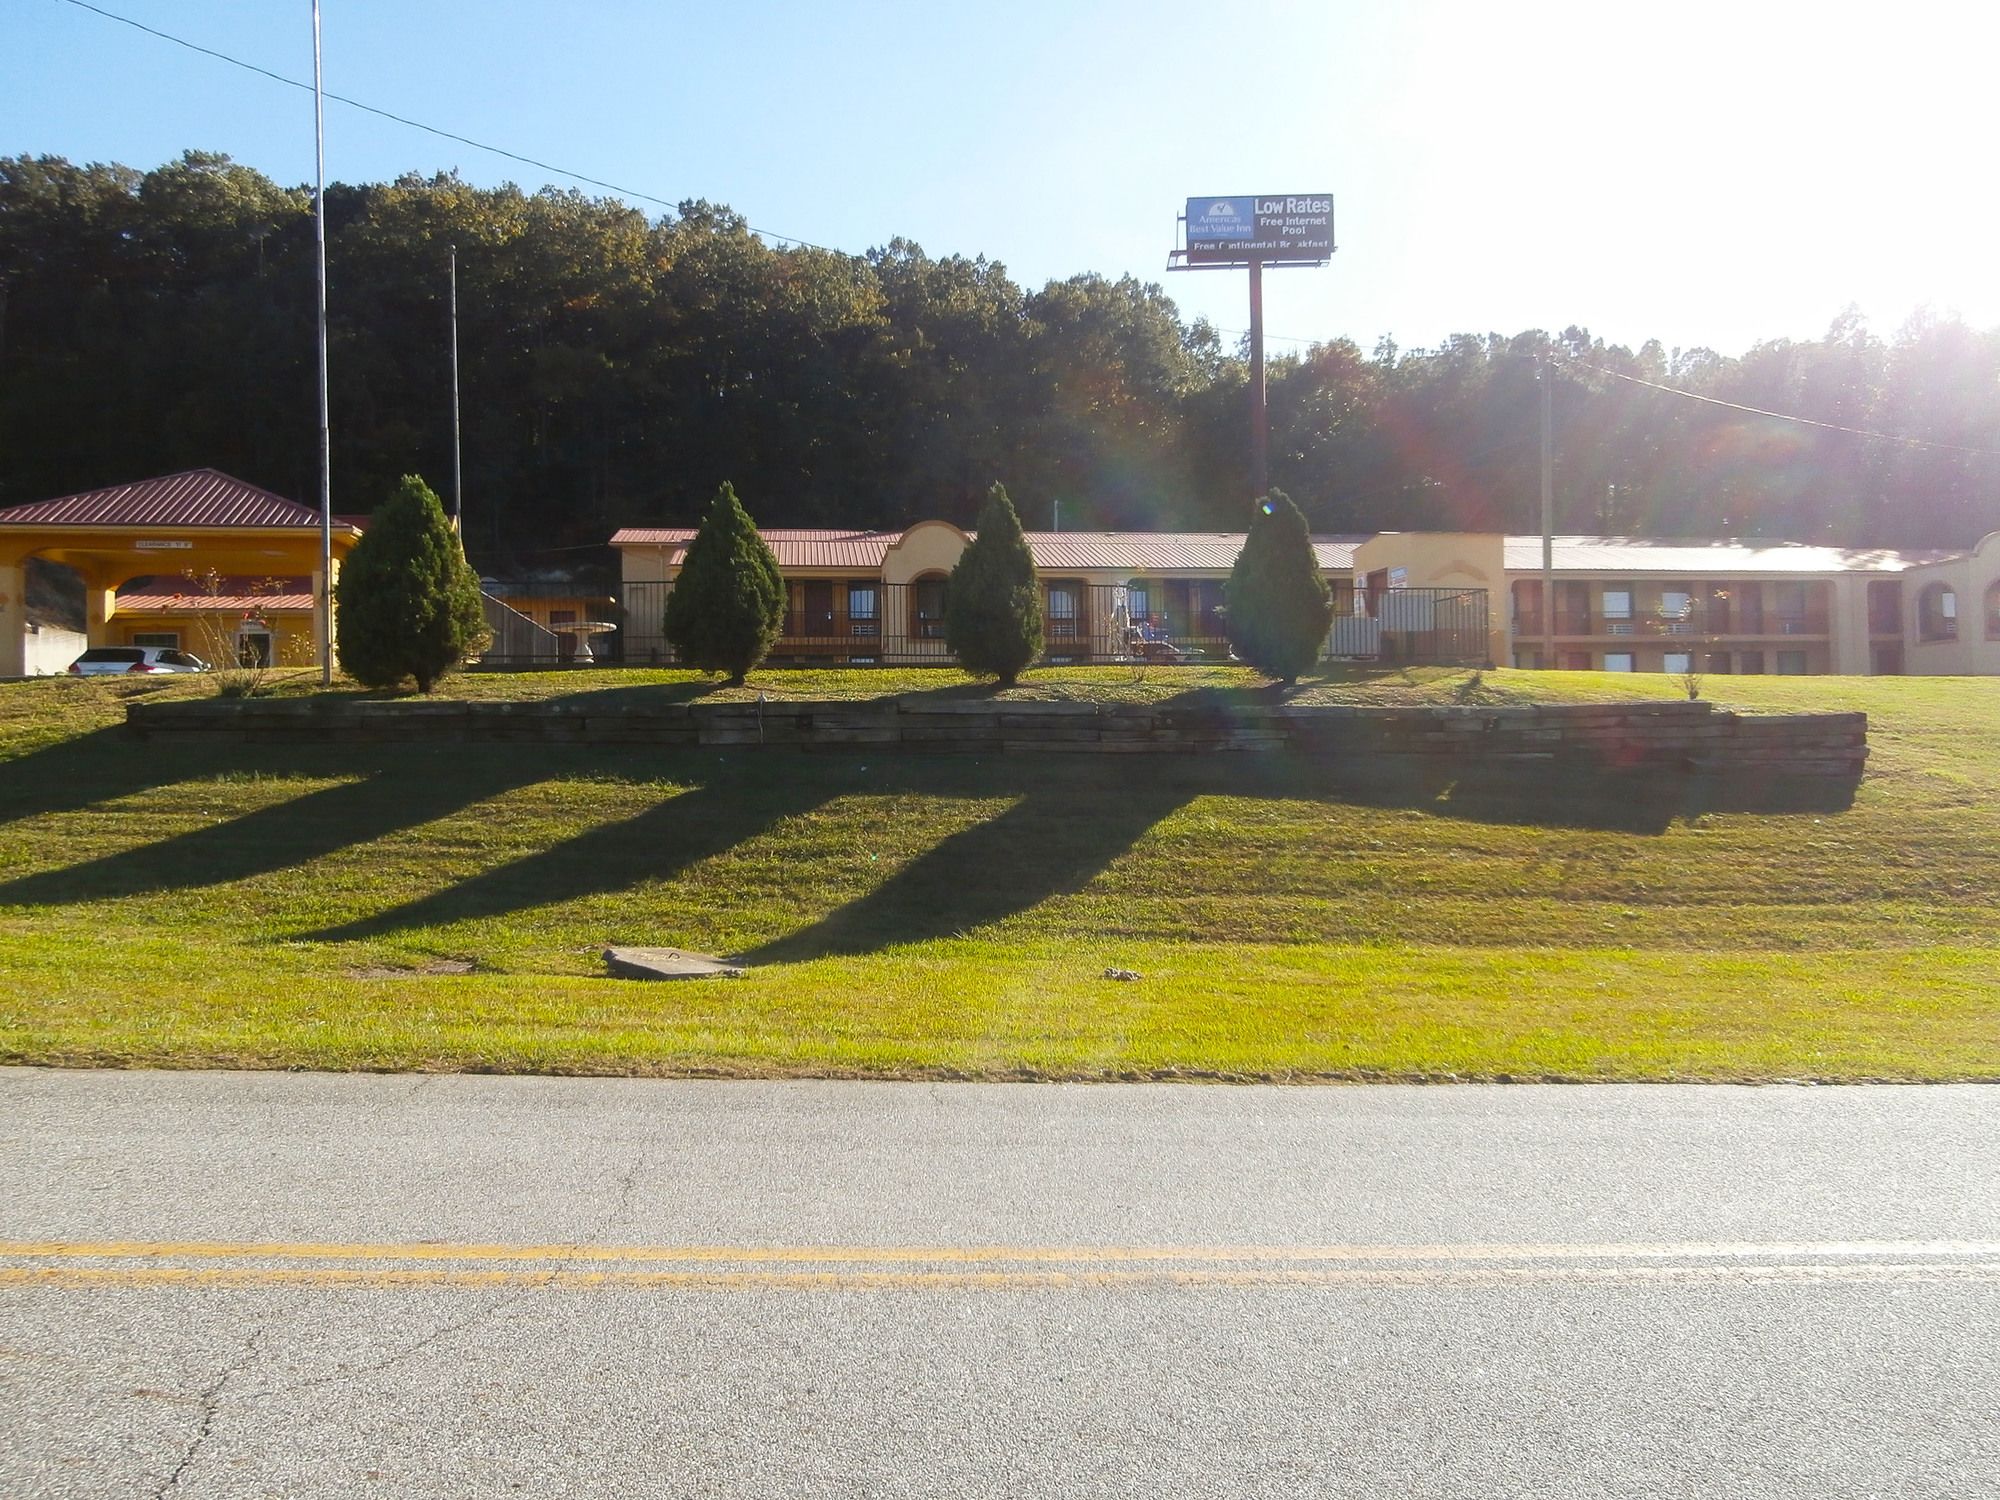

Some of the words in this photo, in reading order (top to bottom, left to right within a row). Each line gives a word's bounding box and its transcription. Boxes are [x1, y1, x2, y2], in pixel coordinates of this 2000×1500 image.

[1255, 198, 1284, 214] Low
[1286, 197, 1330, 213] Rates
[1260, 217, 1283, 226] Free
[1286, 216, 1326, 226] Internet
[1189, 224, 1209, 233] Best
[1210, 224, 1236, 233] Value
[1236, 224, 1251, 233] Inn
[1282, 226, 1306, 235] Pool
[1194, 242, 1215, 250] Free
[1218, 241, 1276, 250] Cntinental
[1280, 240, 1328, 249] Brakfast
